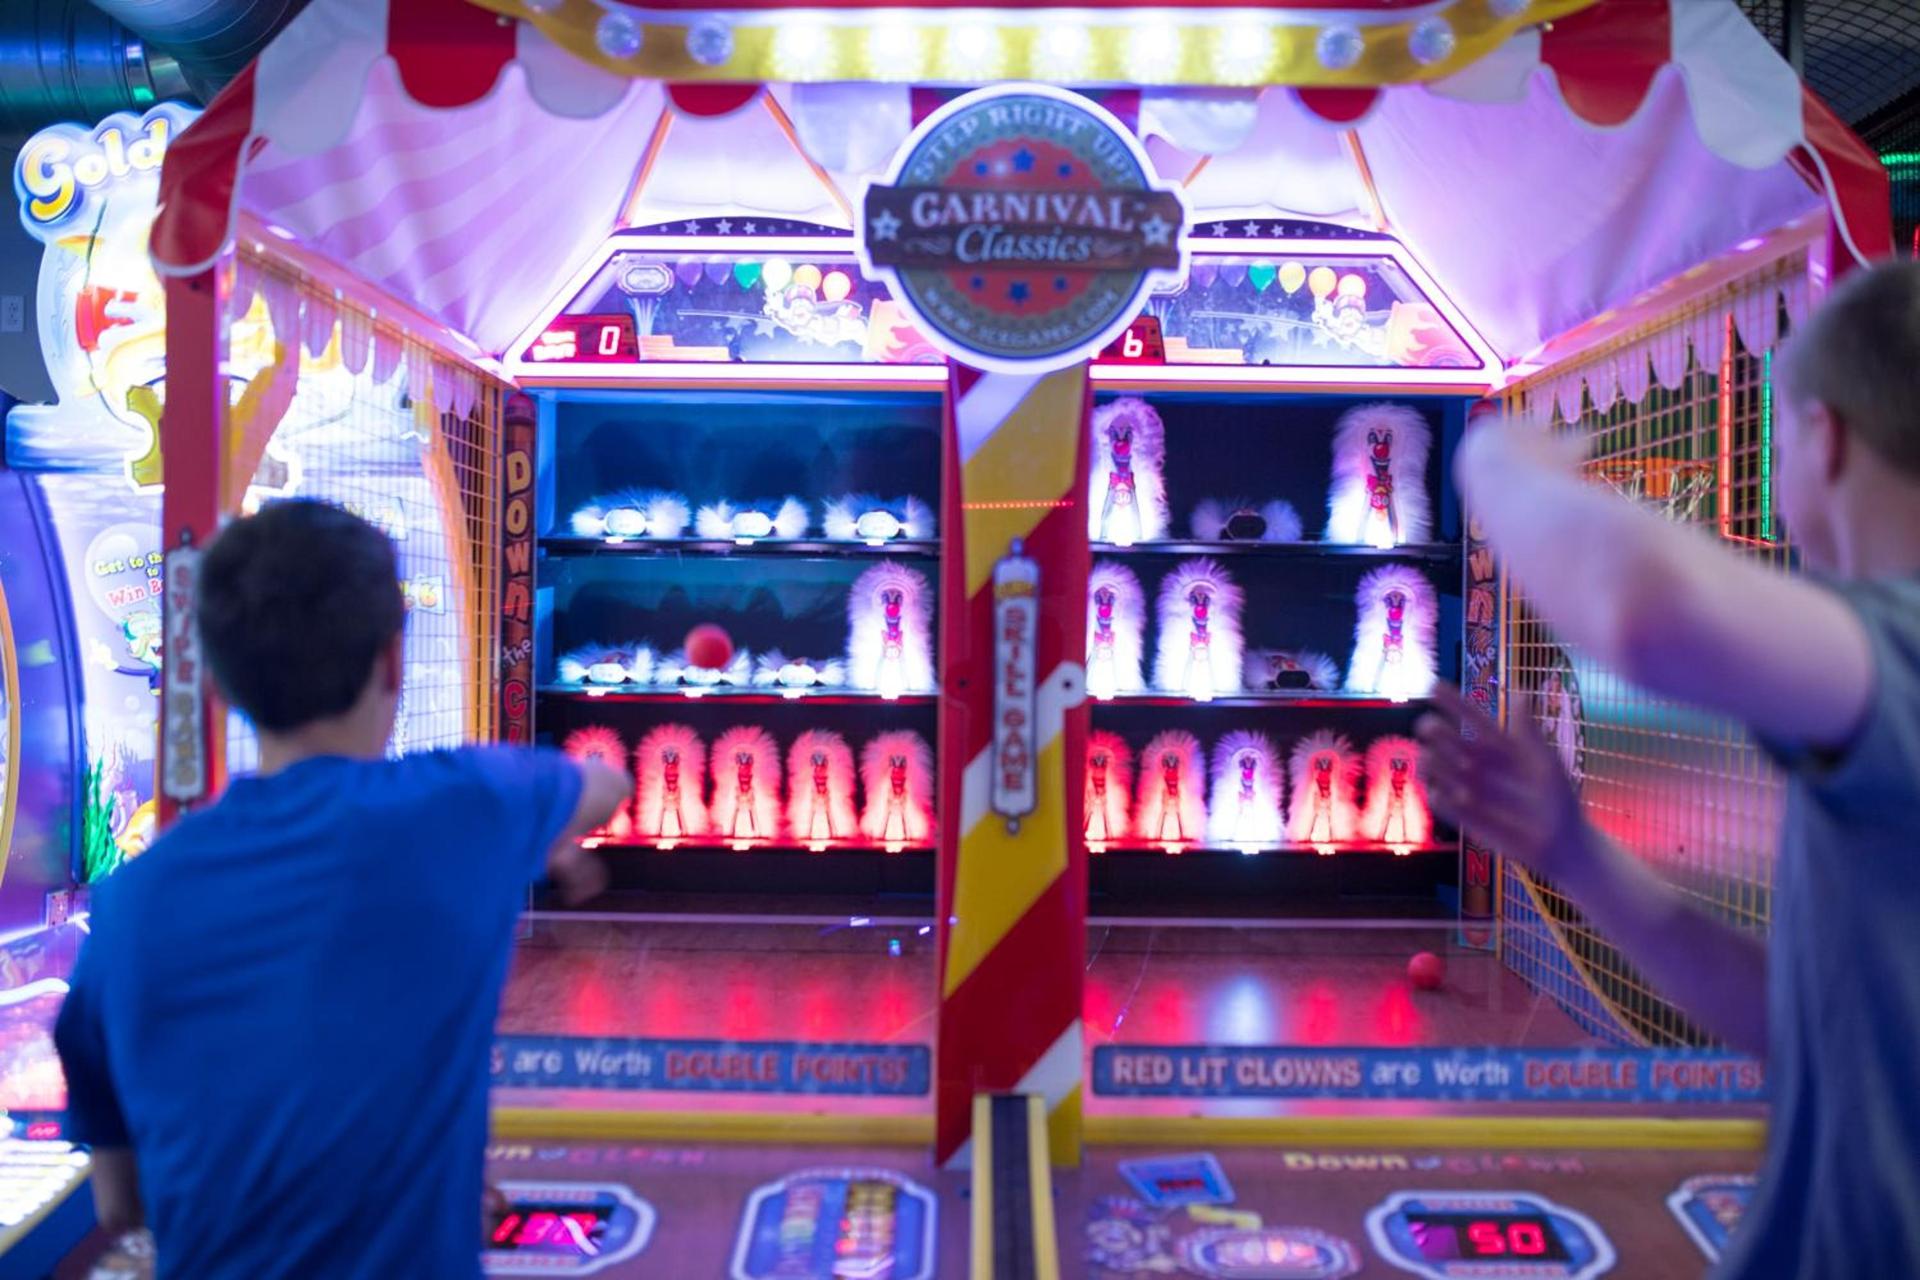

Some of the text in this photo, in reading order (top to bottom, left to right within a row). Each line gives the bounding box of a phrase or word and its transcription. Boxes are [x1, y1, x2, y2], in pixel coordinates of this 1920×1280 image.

[987, 104, 1089, 135] RIGHT
[24, 118, 169, 220] Gold
[911, 193, 1134, 232] CARNIVAL
[956, 225, 1092, 263] Classics
[107, 586, 146, 606] Win
[503, 639, 532, 666] the
[514, 1051, 563, 1074] are
[575, 1049, 652, 1076] Worth
[665, 1051, 777, 1080] DOUBLE
[1112, 1056, 1173, 1084] RED
[1181, 1057, 1228, 1085] LIT
[1236, 1058, 1362, 1087] CLOWNS
[1371, 1062, 1420, 1086] are
[1434, 1060, 1509, 1087] Worth
[1525, 1060, 1638, 1089] DOUBLE
[1467, 1221, 1546, 1255] 50
